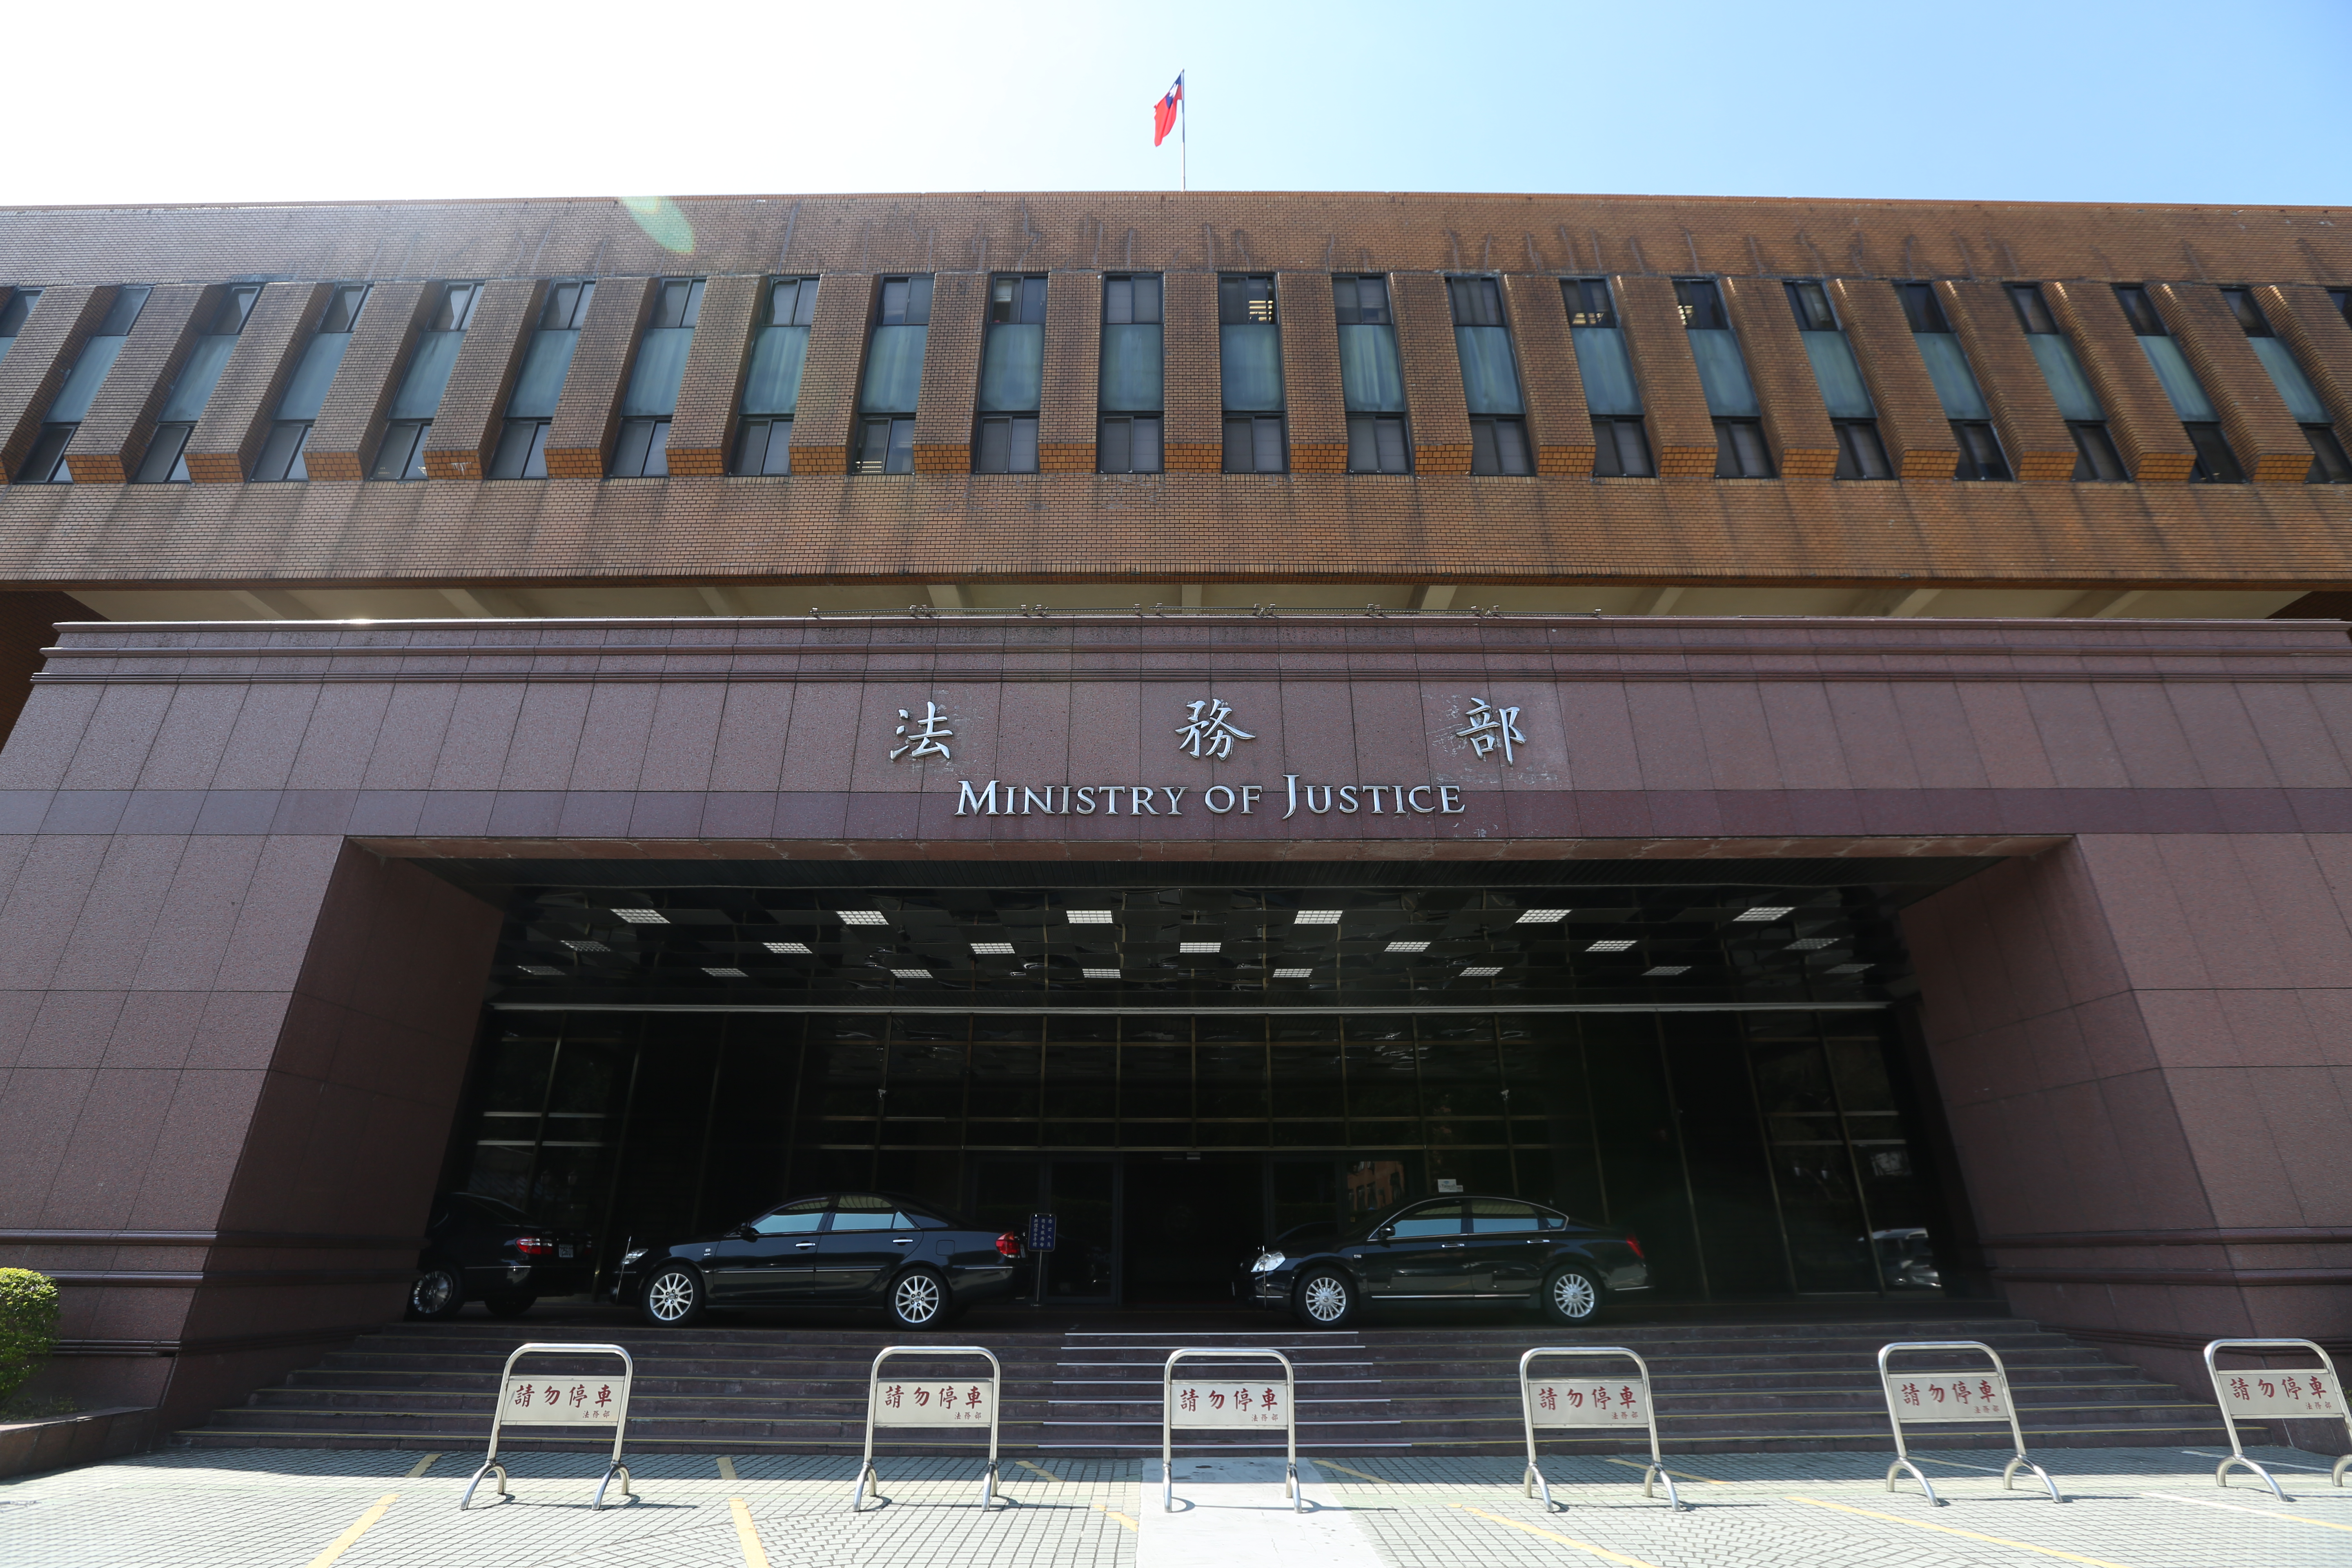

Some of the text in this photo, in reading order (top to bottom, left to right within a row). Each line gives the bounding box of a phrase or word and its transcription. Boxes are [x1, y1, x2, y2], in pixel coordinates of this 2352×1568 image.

[890, 697, 1527, 766] 法務部
[514, 1383, 612, 1408] 請勿停車
[885, 1385, 982, 1409] 請勿停車
[1180, 1388, 1277, 1412] 請勿停車
[1539, 1385, 1636, 1410] 請勿停車
[1901, 1379, 1996, 1406] 請勿停車
[2230, 1375, 2327, 1401] 請勿停車
[583, 1410, 610, 1419] 法務部
[955, 1412, 981, 1420] 法務部
[1251, 1414, 1278, 1422] 法務部
